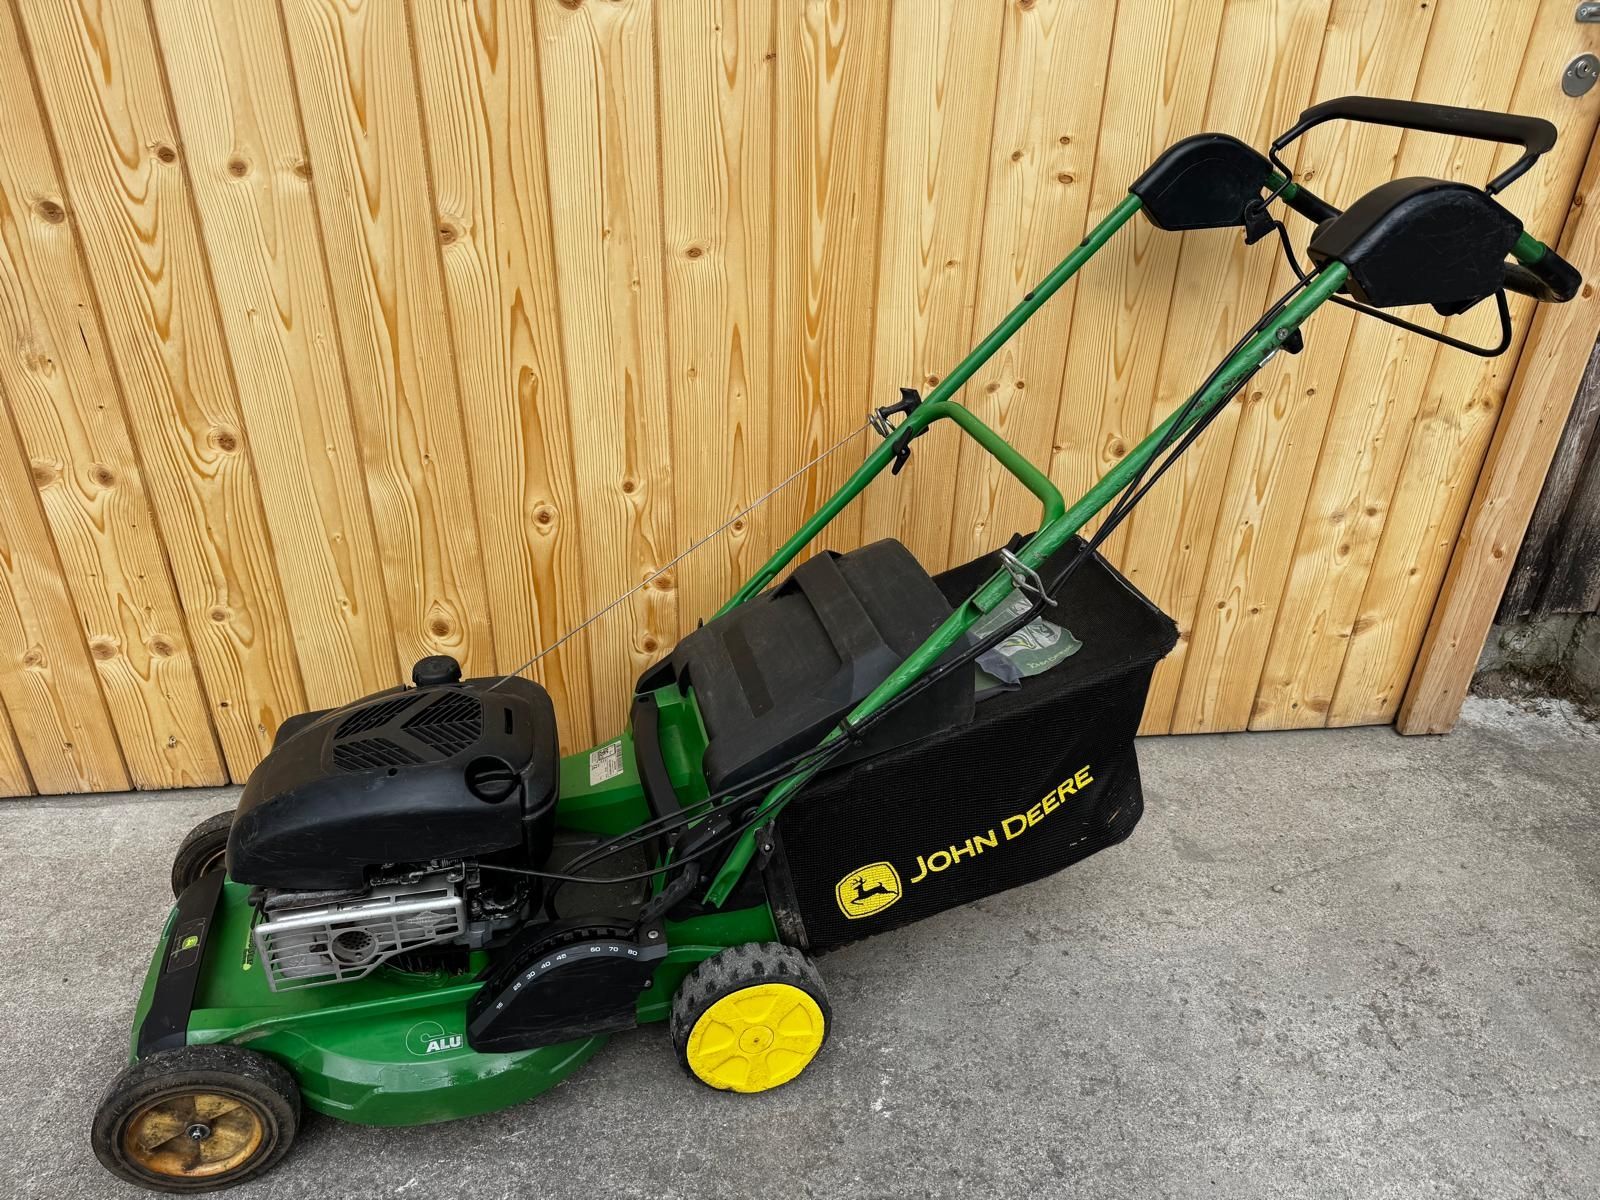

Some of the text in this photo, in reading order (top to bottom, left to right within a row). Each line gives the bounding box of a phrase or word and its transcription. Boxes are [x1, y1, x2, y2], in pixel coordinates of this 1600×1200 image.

[910, 764, 1095, 884] JOHN DEERE
[513, 982, 522, 991] 25
[526, 971, 536, 980] 30
[540, 961, 551, 969] 40
[556, 953, 567, 961] 45
[627, 949, 638, 957] 80
[426, 1035, 461, 1053] ALU
